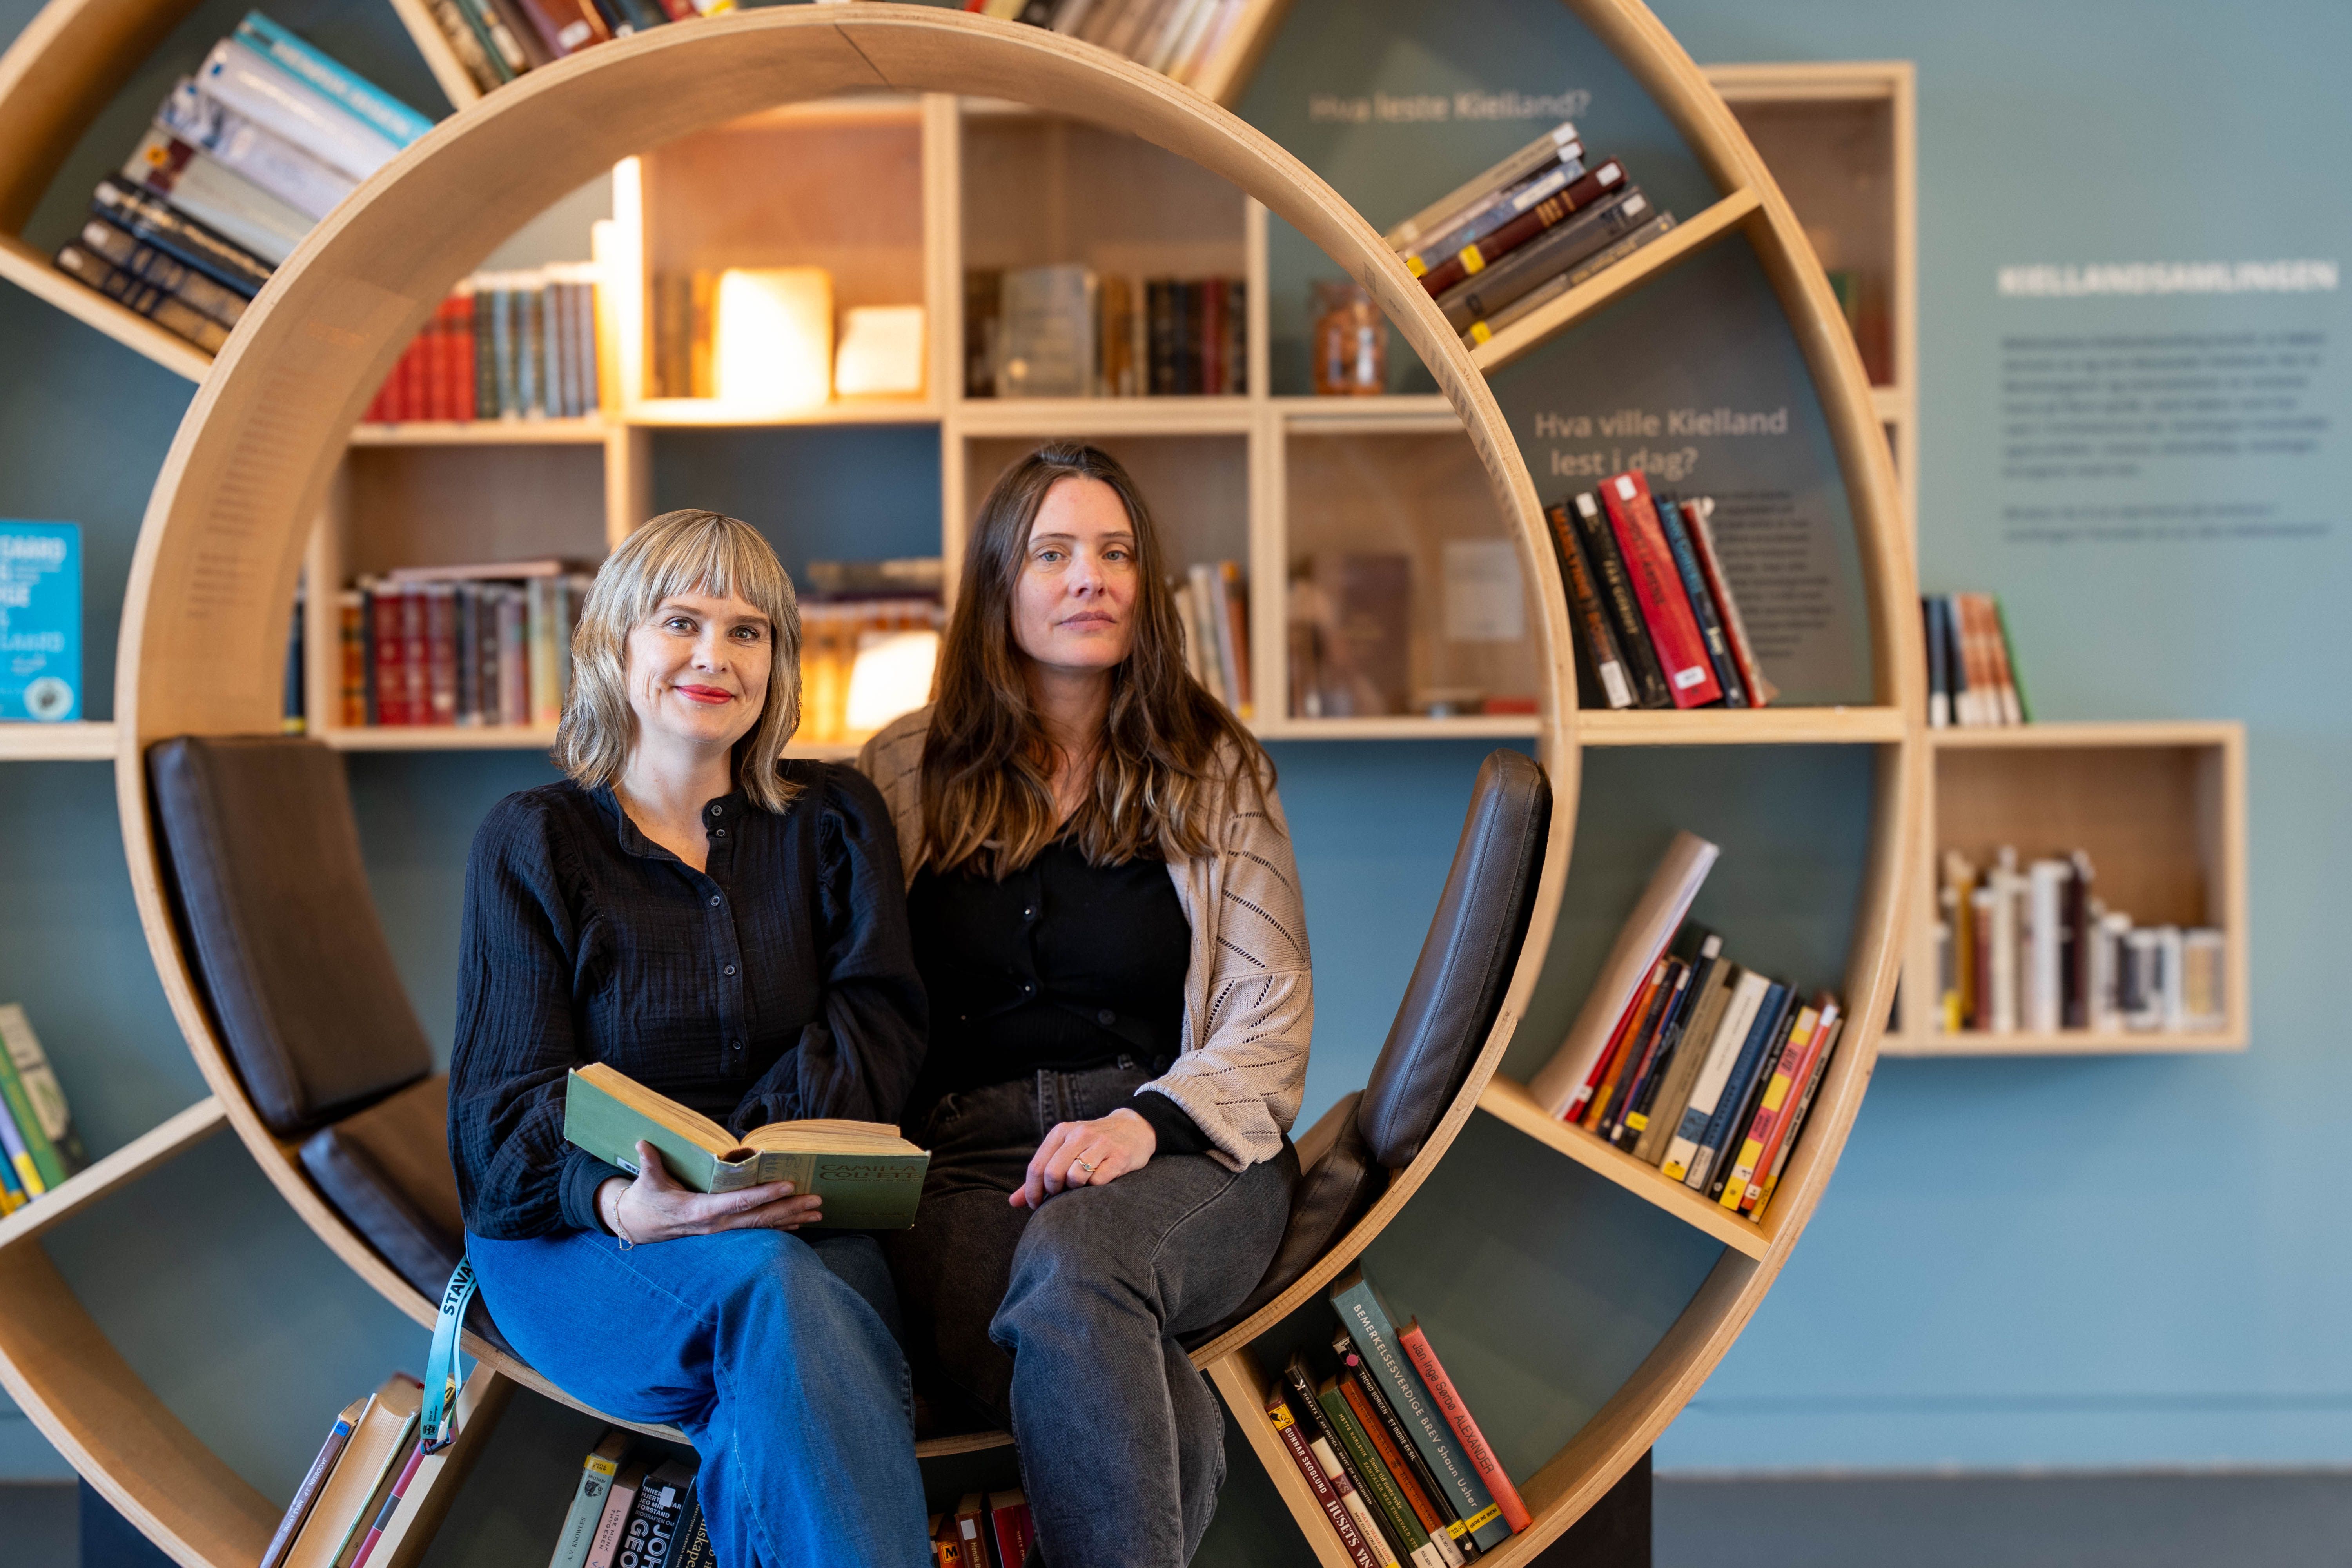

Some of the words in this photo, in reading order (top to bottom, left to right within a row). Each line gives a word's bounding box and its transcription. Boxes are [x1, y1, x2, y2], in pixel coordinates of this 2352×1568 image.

[1535, 411, 1591, 439] Hva
[1600, 408, 1659, 437] ville
[1668, 407, 1788, 436] Kielland
[1551, 448, 1604, 475] lest
[1629, 446, 1699, 481] dag?
[443, 1260, 472, 1316] STAVA
[1353, 1304, 1424, 1416] BEMERKELSESVERDIGE
[1420, 1417, 1441, 1443] BREV
[1438, 1445, 1458, 1477] Shaun
[1457, 1478, 1477, 1508] Usher
[1359, 1372, 1374, 1392] TROND
[1372, 1391, 1388, 1415] BORGEN
[1393, 1426, 1407, 1445] INDRE
[1405, 1444, 1416, 1461] EKSIL
[1412, 1343, 1426, 1360] Jan
[1422, 1359, 1439, 1382] Inge
[1436, 1381, 1456, 1412] Sørbø
[1454, 1415, 1494, 1474] ALEXANDER
[1339, 1414, 1351, 1431] METTE
[1350, 1432, 1367, 1457] KARLSVIK
[1303, 1393, 1318, 1415] HORATS
[1326, 1430, 1338, 1448] POETICA
[1339, 1451, 1349, 1466] BREVET
[1348, 1467, 1354, 1476] OM
[1353, 1474, 1372, 1505] DIKTEKUNSTEN
[308, 1457, 327, 1486] JACOBSEN,
[588, 1474, 606, 1483] ATHLONE
[1369, 1457, 1380, 1475] Same
[1383, 1479, 1396, 1497] neste
[1392, 1494, 1402, 1510] veke
[641, 1492, 660, 1502] HJERT
[643, 1486, 661, 1497] INNER
[1285, 1428, 1304, 1456] GUNNAR
[1302, 1456, 1327, 1494] SKOGLUND
[1327, 1501, 1359, 1547] HUSETS
[1336, 1479, 1350, 1494] XS
[293, 1500, 304, 1515] NIELS
[637, 1503, 670, 1518] FORSTAND
[651, 1502, 664, 1510] MIN
[1363, 1461, 1384, 1494] SAMTALER
[1382, 1492, 1392, 1506] MED
[1390, 1505, 1411, 1537] THORVALD
[283, 1514, 295, 1533] LYHNE
[612, 1510, 621, 1527] LISE
[635, 1510, 665, 1524] BIOGRAFIEN
[1354, 1512, 1363, 1524] BREV
[1419, 1503, 1438, 1530] CAMON
[1469, 1515, 1486, 1529] q808.86
[1486, 1508, 1498, 1519] BEM
[572, 1517, 586, 1548] KNOWLES
[599, 1509, 616, 1549] THYGESEN
[604, 1530, 615, 1552] MUNK
[1359, 1512, 1372, 1528] MARIO
[1370, 1528, 1383, 1548] VARGAS
[1381, 1548, 1392, 1563] LLOSA
[946, 1546, 958, 1559] M
[971, 1543, 979, 1563] Henrik
[1438, 1534, 1449, 1547] 944.361
[1447, 1546, 1453, 1554] DE
